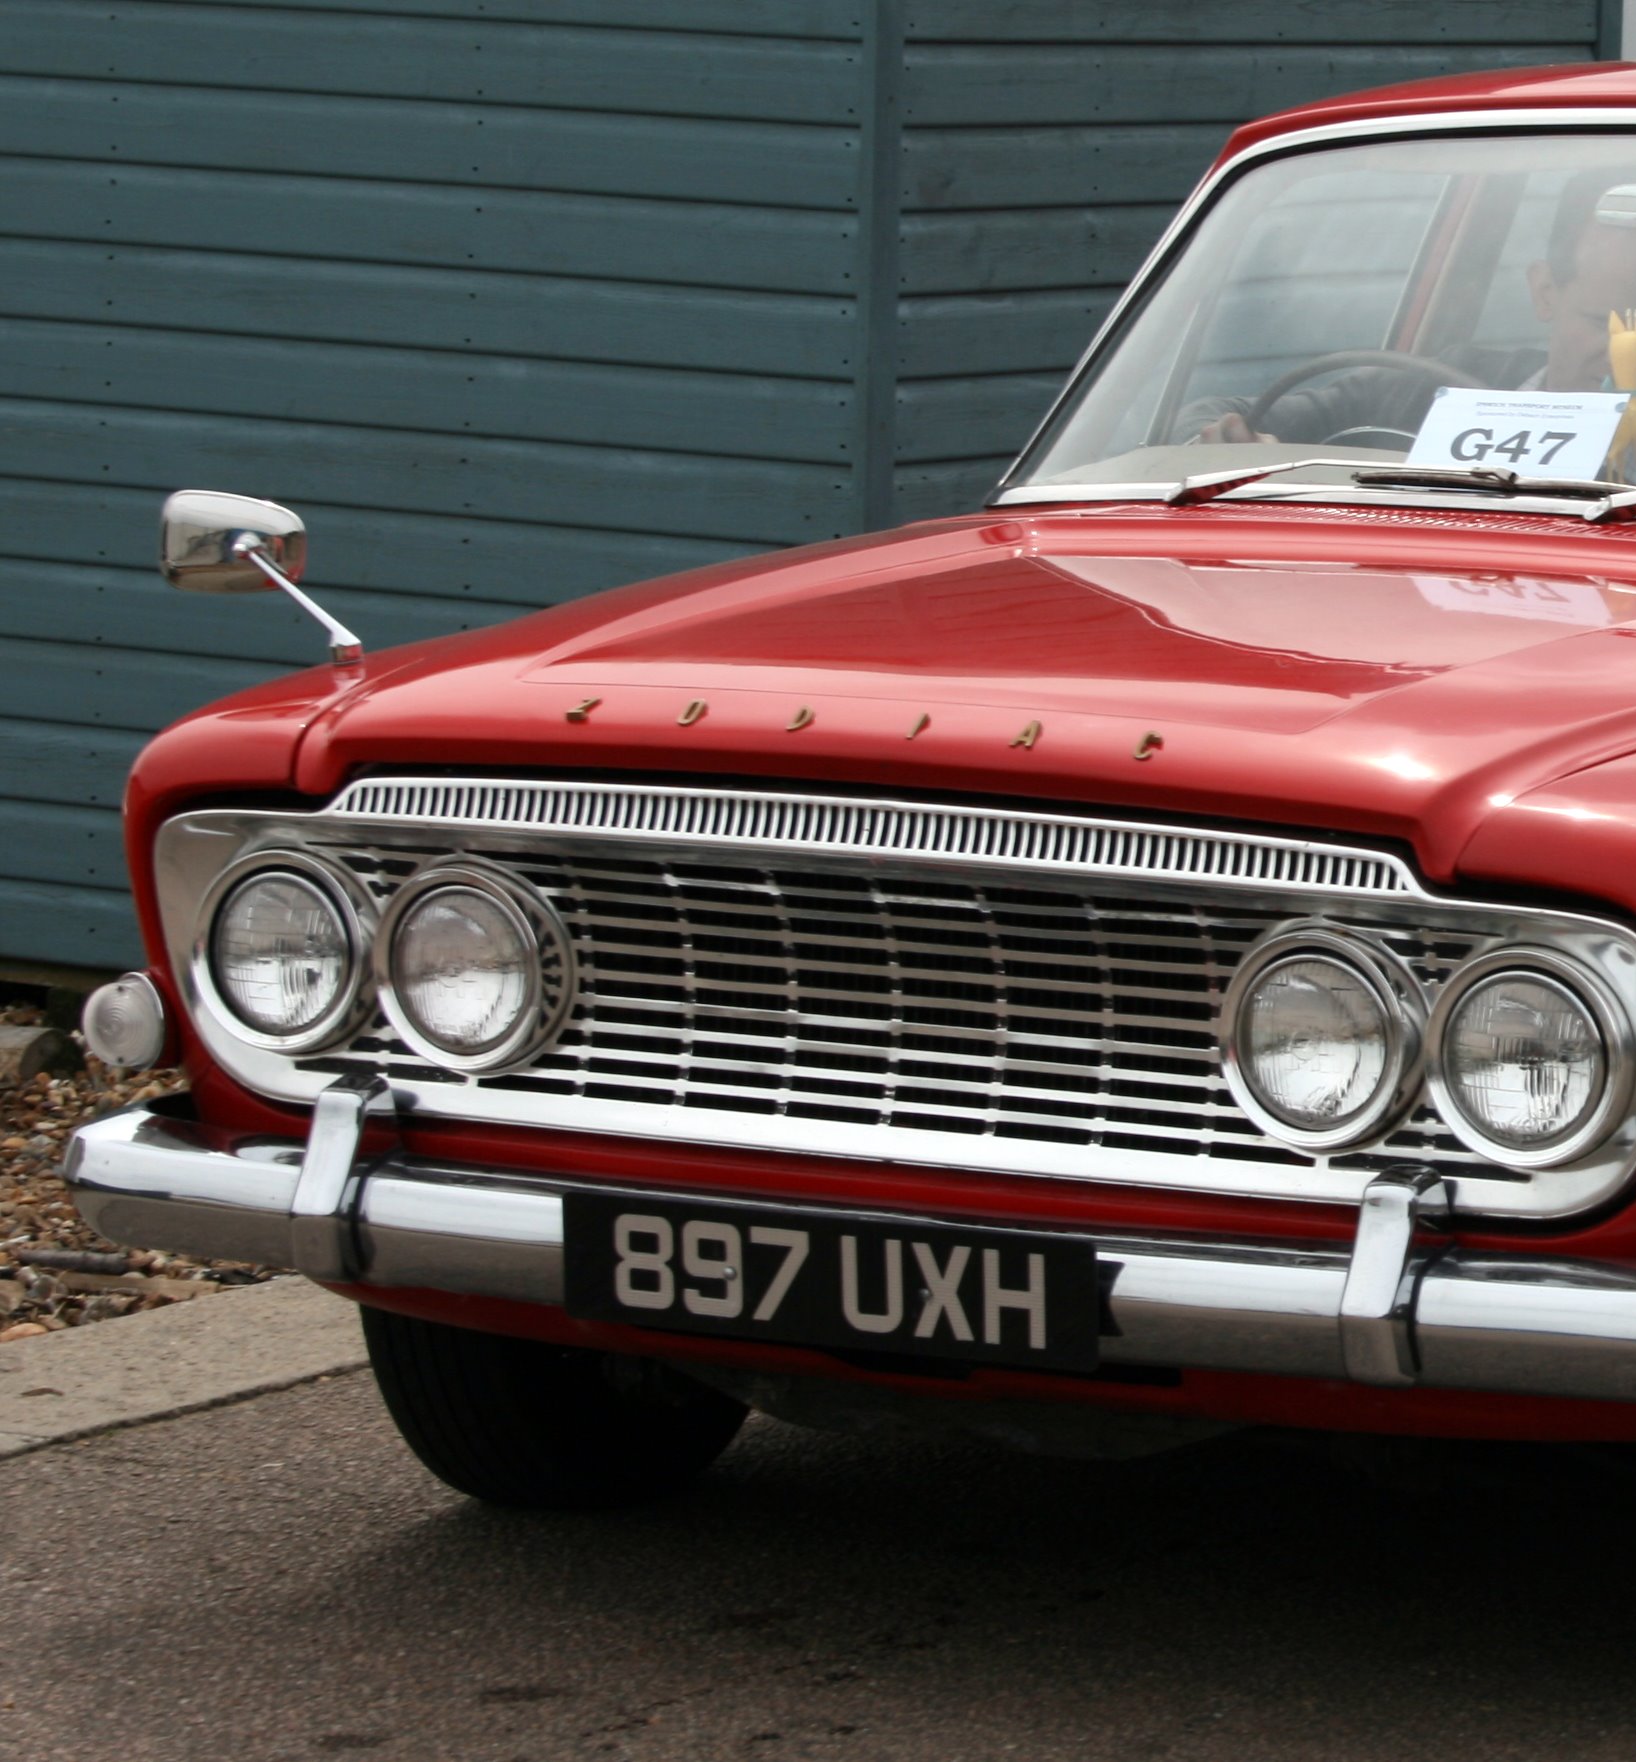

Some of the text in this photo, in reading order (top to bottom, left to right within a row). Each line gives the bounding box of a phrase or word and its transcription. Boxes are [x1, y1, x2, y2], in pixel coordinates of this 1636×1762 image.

[1450, 428, 1577, 465] G47
[566, 697, 1164, 761] ZODIAC
[614, 1213, 1046, 1350] 897 UXH
